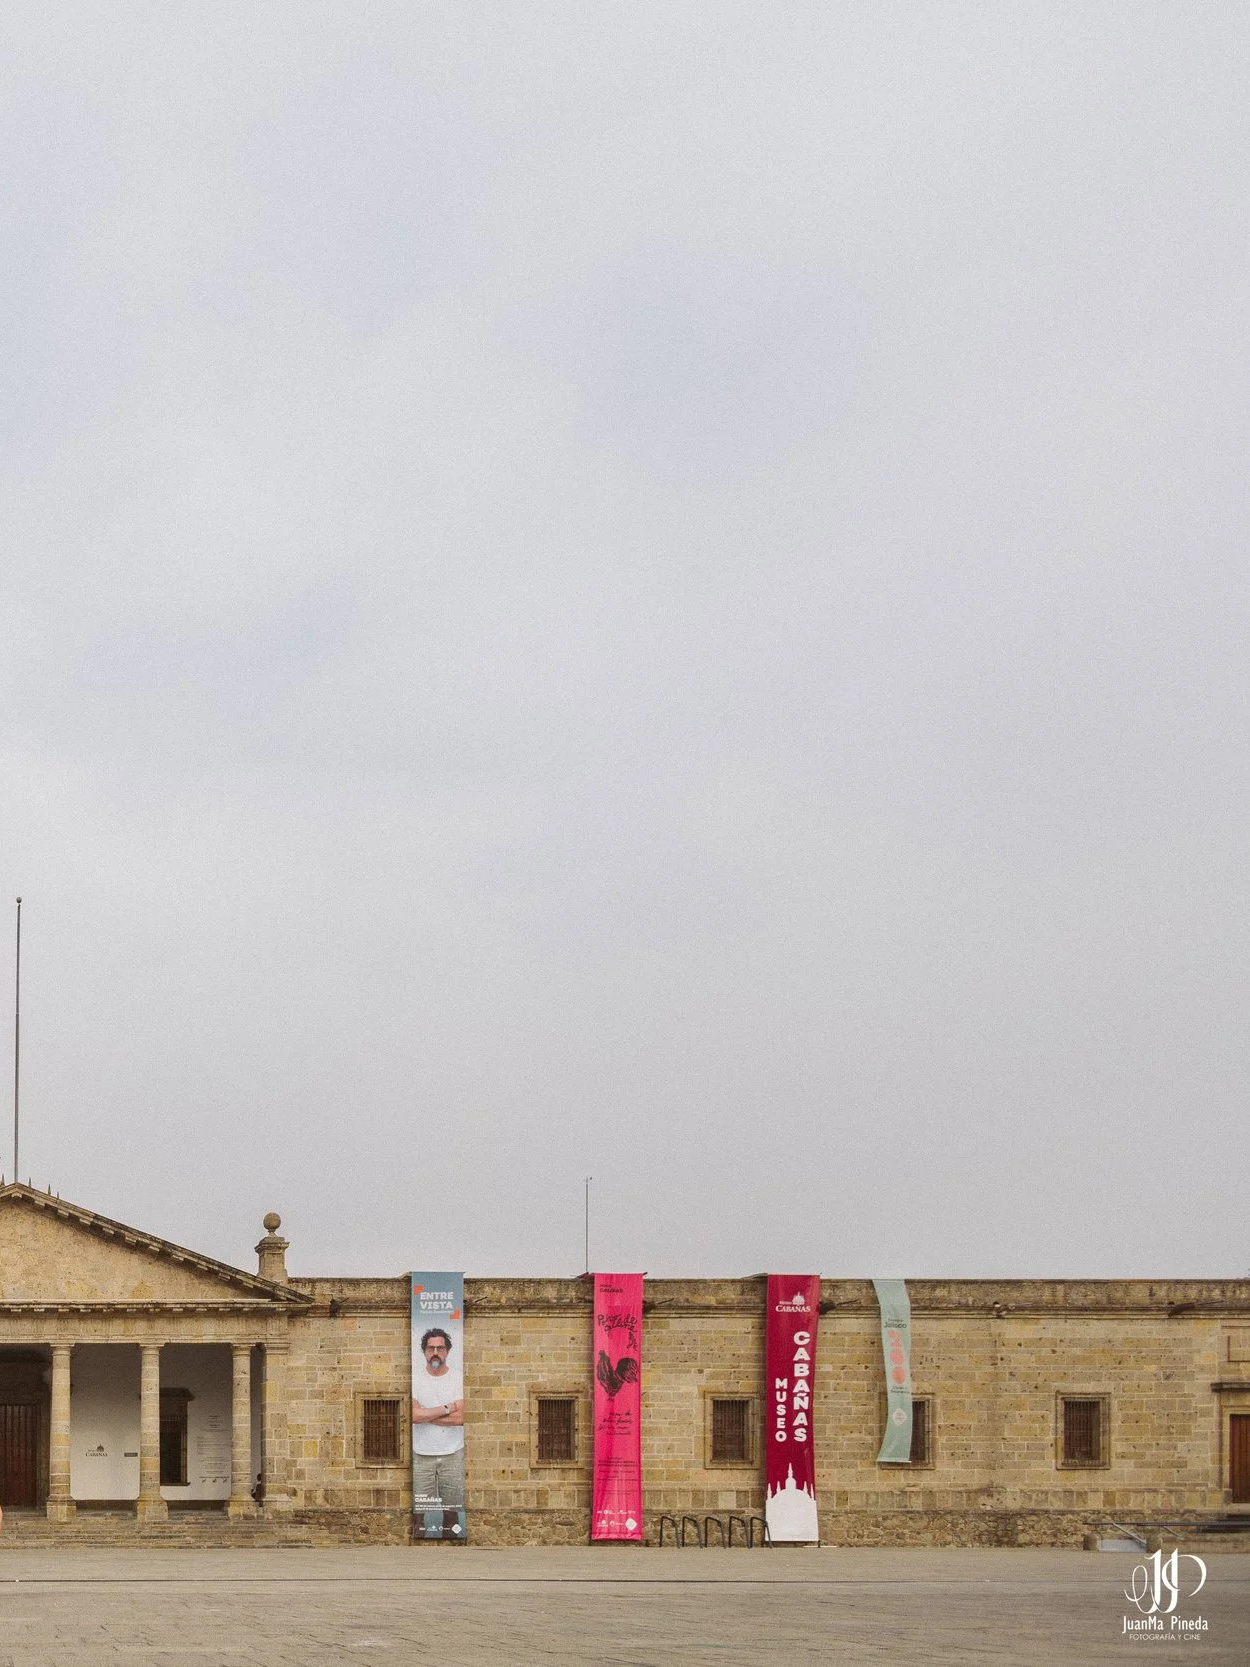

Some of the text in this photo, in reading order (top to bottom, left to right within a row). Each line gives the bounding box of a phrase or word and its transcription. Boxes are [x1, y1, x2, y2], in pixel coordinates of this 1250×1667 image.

[420, 1291, 454, 1300] ENTRE
[420, 1301, 453, 1310] VISTA
[793, 1331, 811, 1442] CABAÑAS
[775, 1377, 788, 1443] MUSEO
